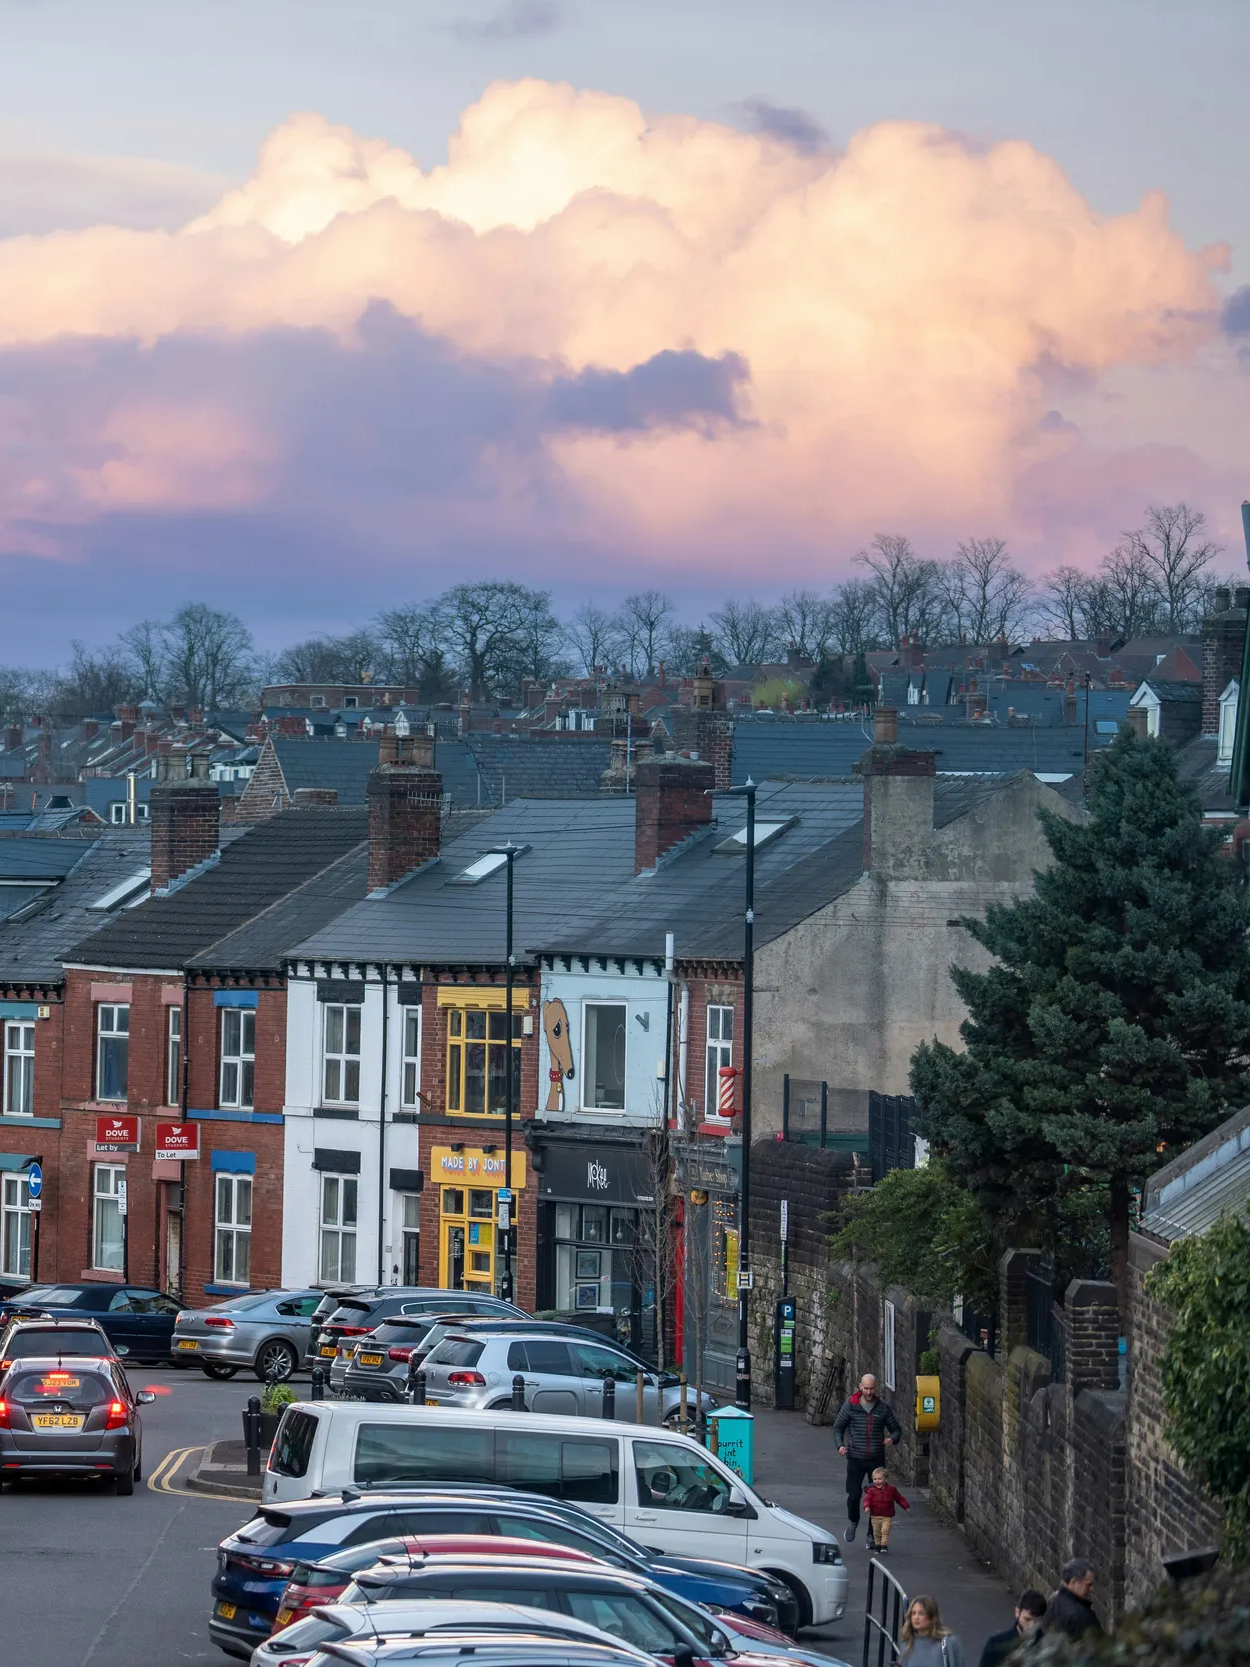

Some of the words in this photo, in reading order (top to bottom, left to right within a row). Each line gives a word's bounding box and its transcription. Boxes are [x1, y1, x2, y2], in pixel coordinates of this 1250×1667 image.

[441, 1155, 464, 1170] MADE
[468, 1157, 479, 1171] BY
[784, 1305, 792, 1317] P
[37, 1416, 60, 1426] YF62
[61, 1416, 79, 1426] LZB
[724, 1448, 737, 1457] int
